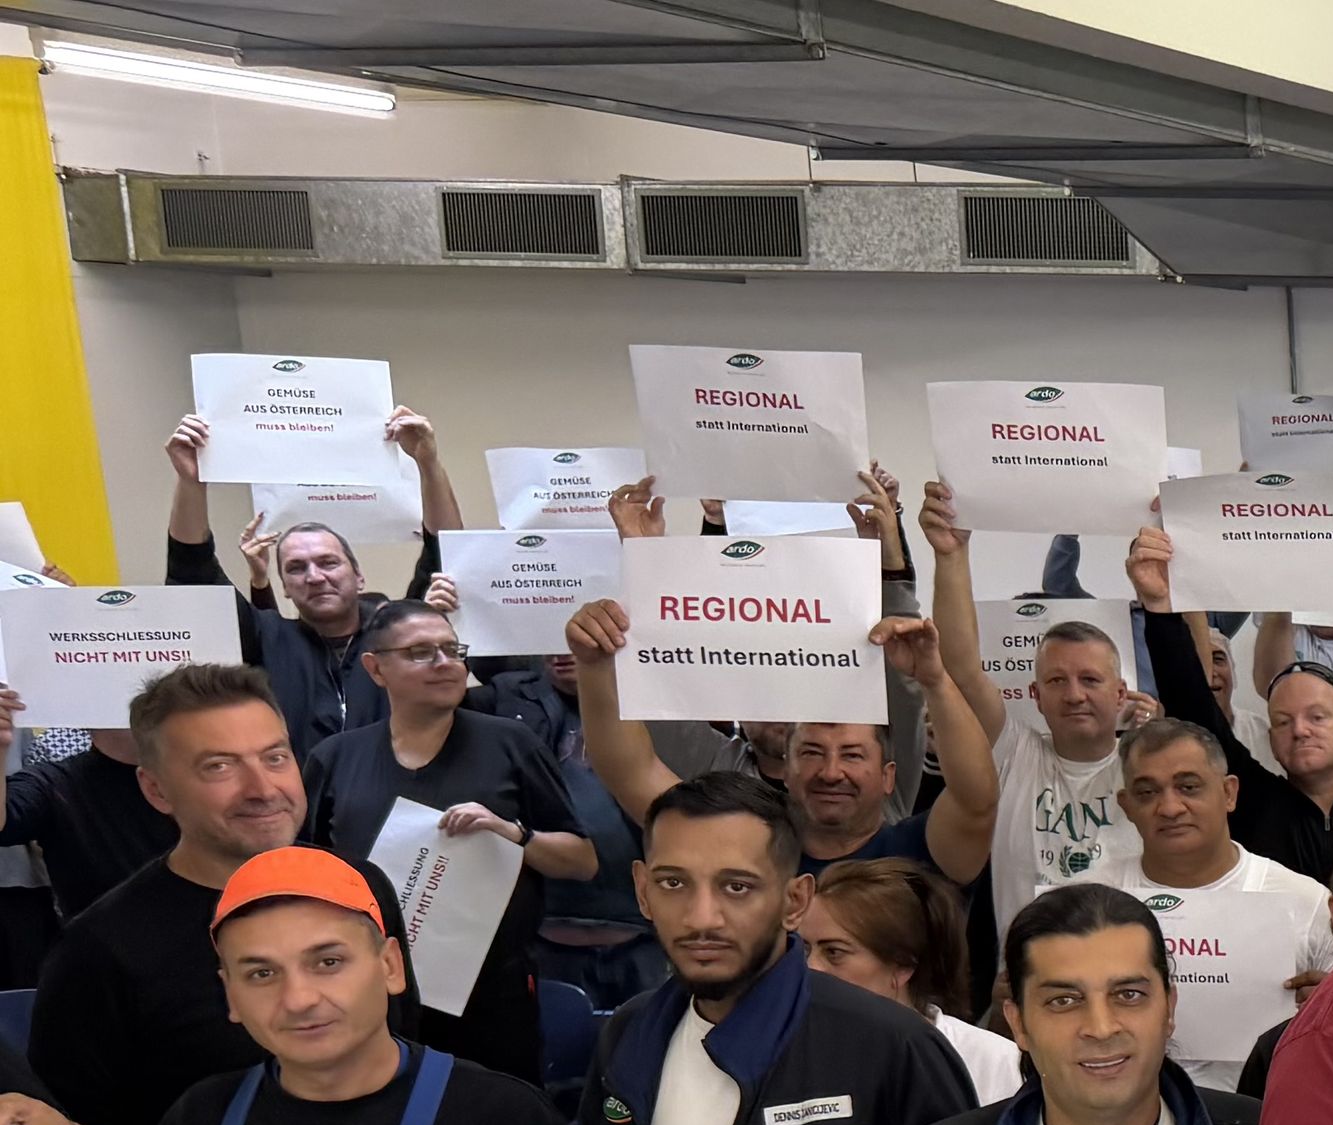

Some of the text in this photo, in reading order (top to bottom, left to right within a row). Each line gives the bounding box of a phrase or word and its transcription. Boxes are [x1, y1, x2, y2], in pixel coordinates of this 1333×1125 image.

[268, 388, 315, 399] GEMÜSE
[695, 388, 804, 410] REGIONAL
[244, 404, 342, 416] AUS ÖSTERREICH
[289, 424, 334, 432] bleiben!
[696, 420, 808, 434] statt International
[992, 424, 1104, 442] REGIONAL
[992, 455, 1108, 467] statt International
[550, 477, 591, 485] GEMÜSE
[1222, 504, 1333, 517] REGIONAL
[1222, 531, 1251, 540] statt
[512, 564, 557, 572] GEMÜSE
[491, 579, 582, 588] AUS ÖSTERREICH
[660, 596, 831, 624] REGIONAL
[49, 631, 191, 642] WERKSSCHLIESSUNG
[55, 650, 191, 663] NICHT MIT UNS!!
[638, 647, 859, 667] statt International
[1040, 849, 1053, 865] 19
[417, 855, 449, 916] MIT UNS!!
